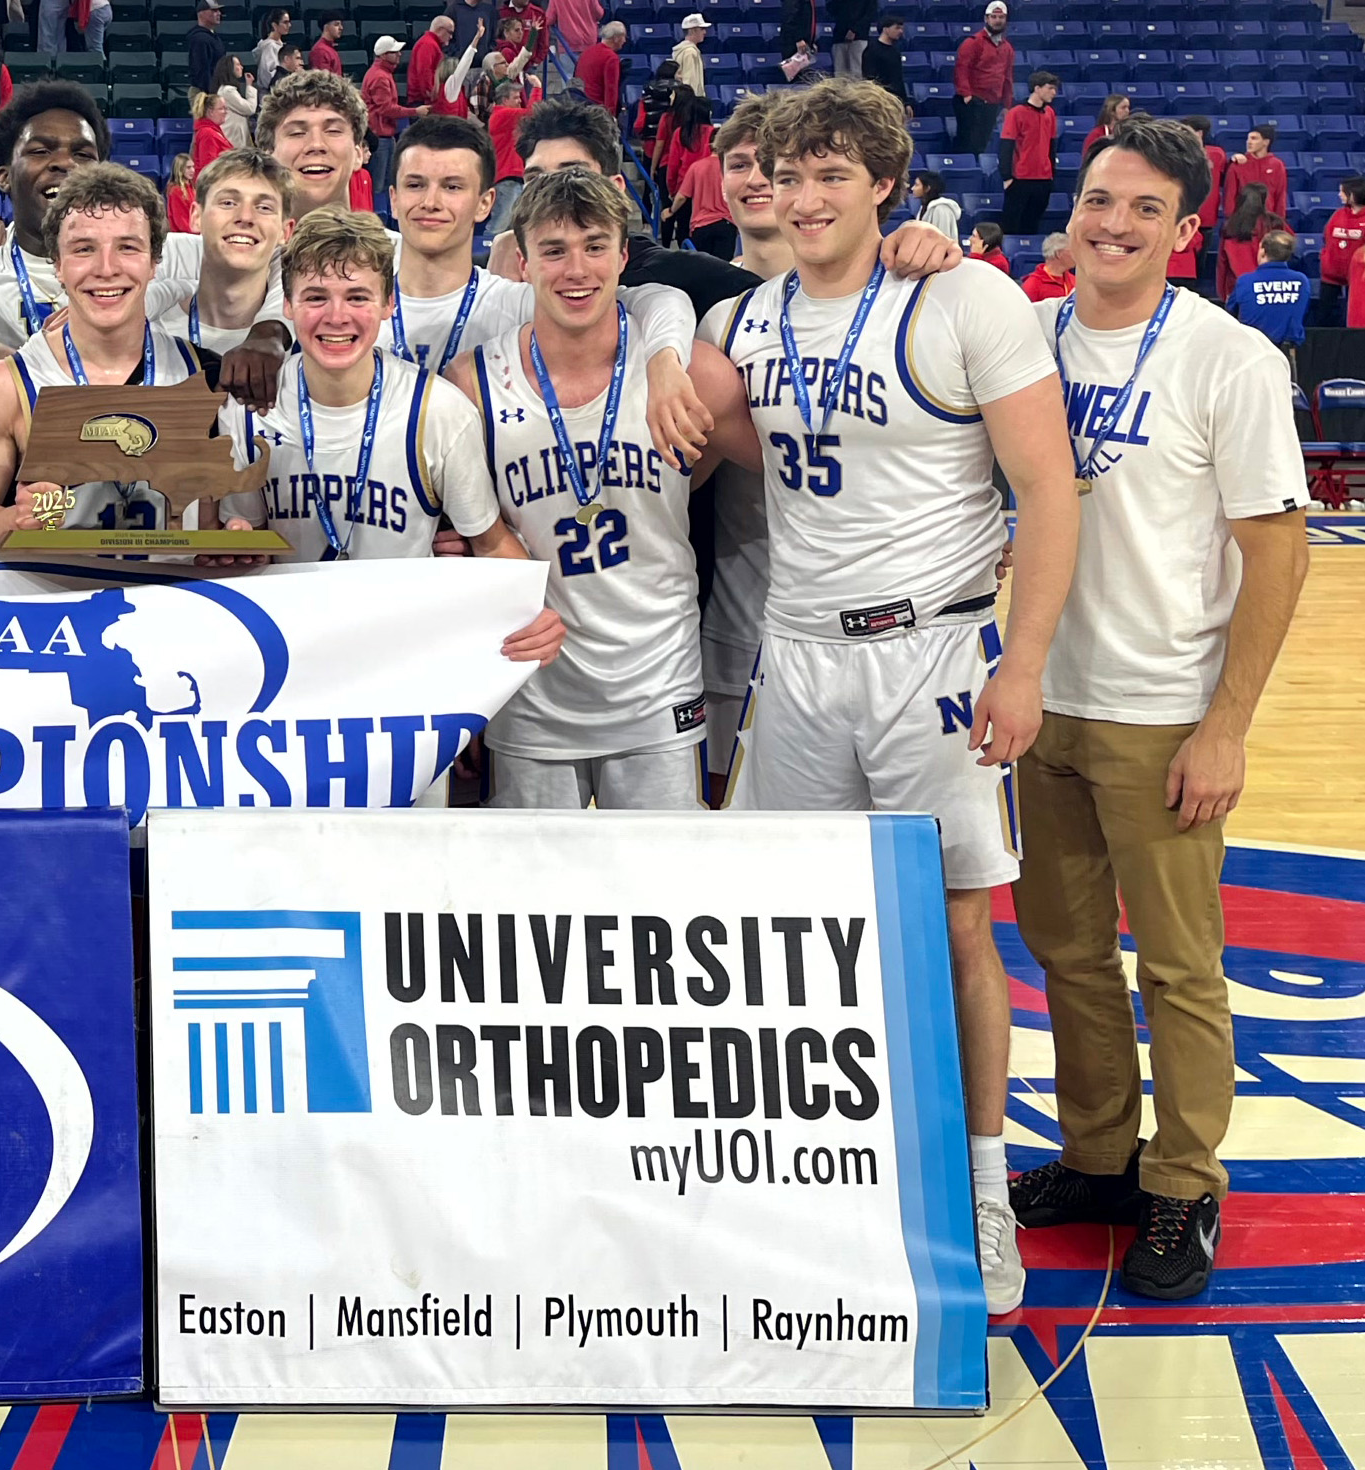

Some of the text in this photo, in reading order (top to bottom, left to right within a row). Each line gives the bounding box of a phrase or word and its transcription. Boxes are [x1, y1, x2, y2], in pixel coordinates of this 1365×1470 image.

[1253, 281, 1301, 293] EVENT
[1256, 293, 1299, 305] STAFF
[856, 302, 868, 330] CHAMPION
[85, 426, 123, 437] MIAA
[556, 423, 566, 452] CHAMPION
[1065, 381, 1151, 446] WELL
[505, 440, 663, 507] CLIPPERS
[571, 468, 583, 497] CHAMPION
[769, 431, 842, 498] 35
[31, 490, 76, 512] 2025
[261, 473, 407, 533] CLIPPERS
[100, 538, 133, 546] DIVISION
[144, 538, 190, 546] CHAMPIONS
[554, 508, 630, 577] 22
[935, 688, 974, 736] N
[385, 913, 865, 1006] UNIVERSITY
[390, 1023, 879, 1120] ORTHOPEDICS
[631, 1129, 877, 1195] myUOI.com
[180, 1293, 285, 1338] Easton
[338, 1293, 491, 1337] Mansfield
[546, 1293, 697, 1348] Plymouth
[753, 1298, 908, 1350] Raynham
